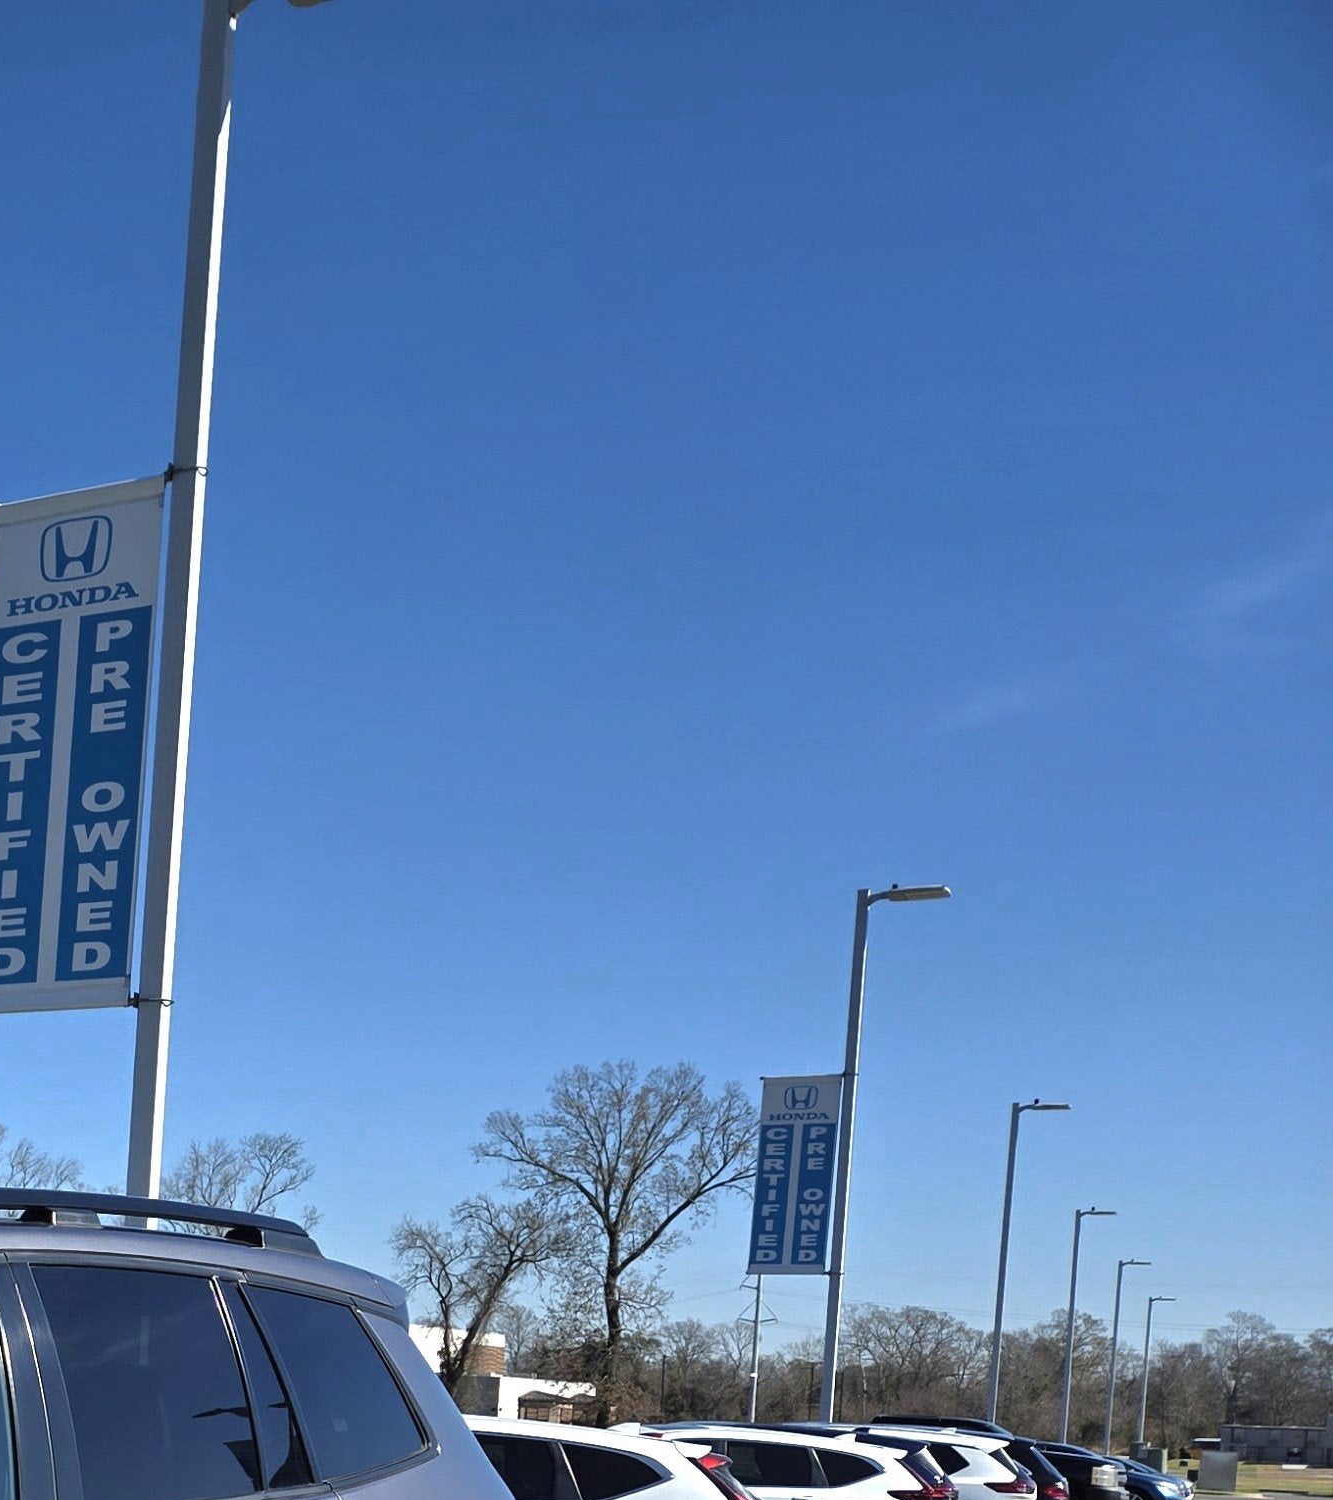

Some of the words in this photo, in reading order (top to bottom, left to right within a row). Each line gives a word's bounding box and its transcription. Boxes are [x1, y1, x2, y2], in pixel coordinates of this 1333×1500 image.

[5, 581, 140, 618] HONDA
[769, 1112, 830, 1122] HONDA
[755, 1127, 789, 1262] CERTIFIED
